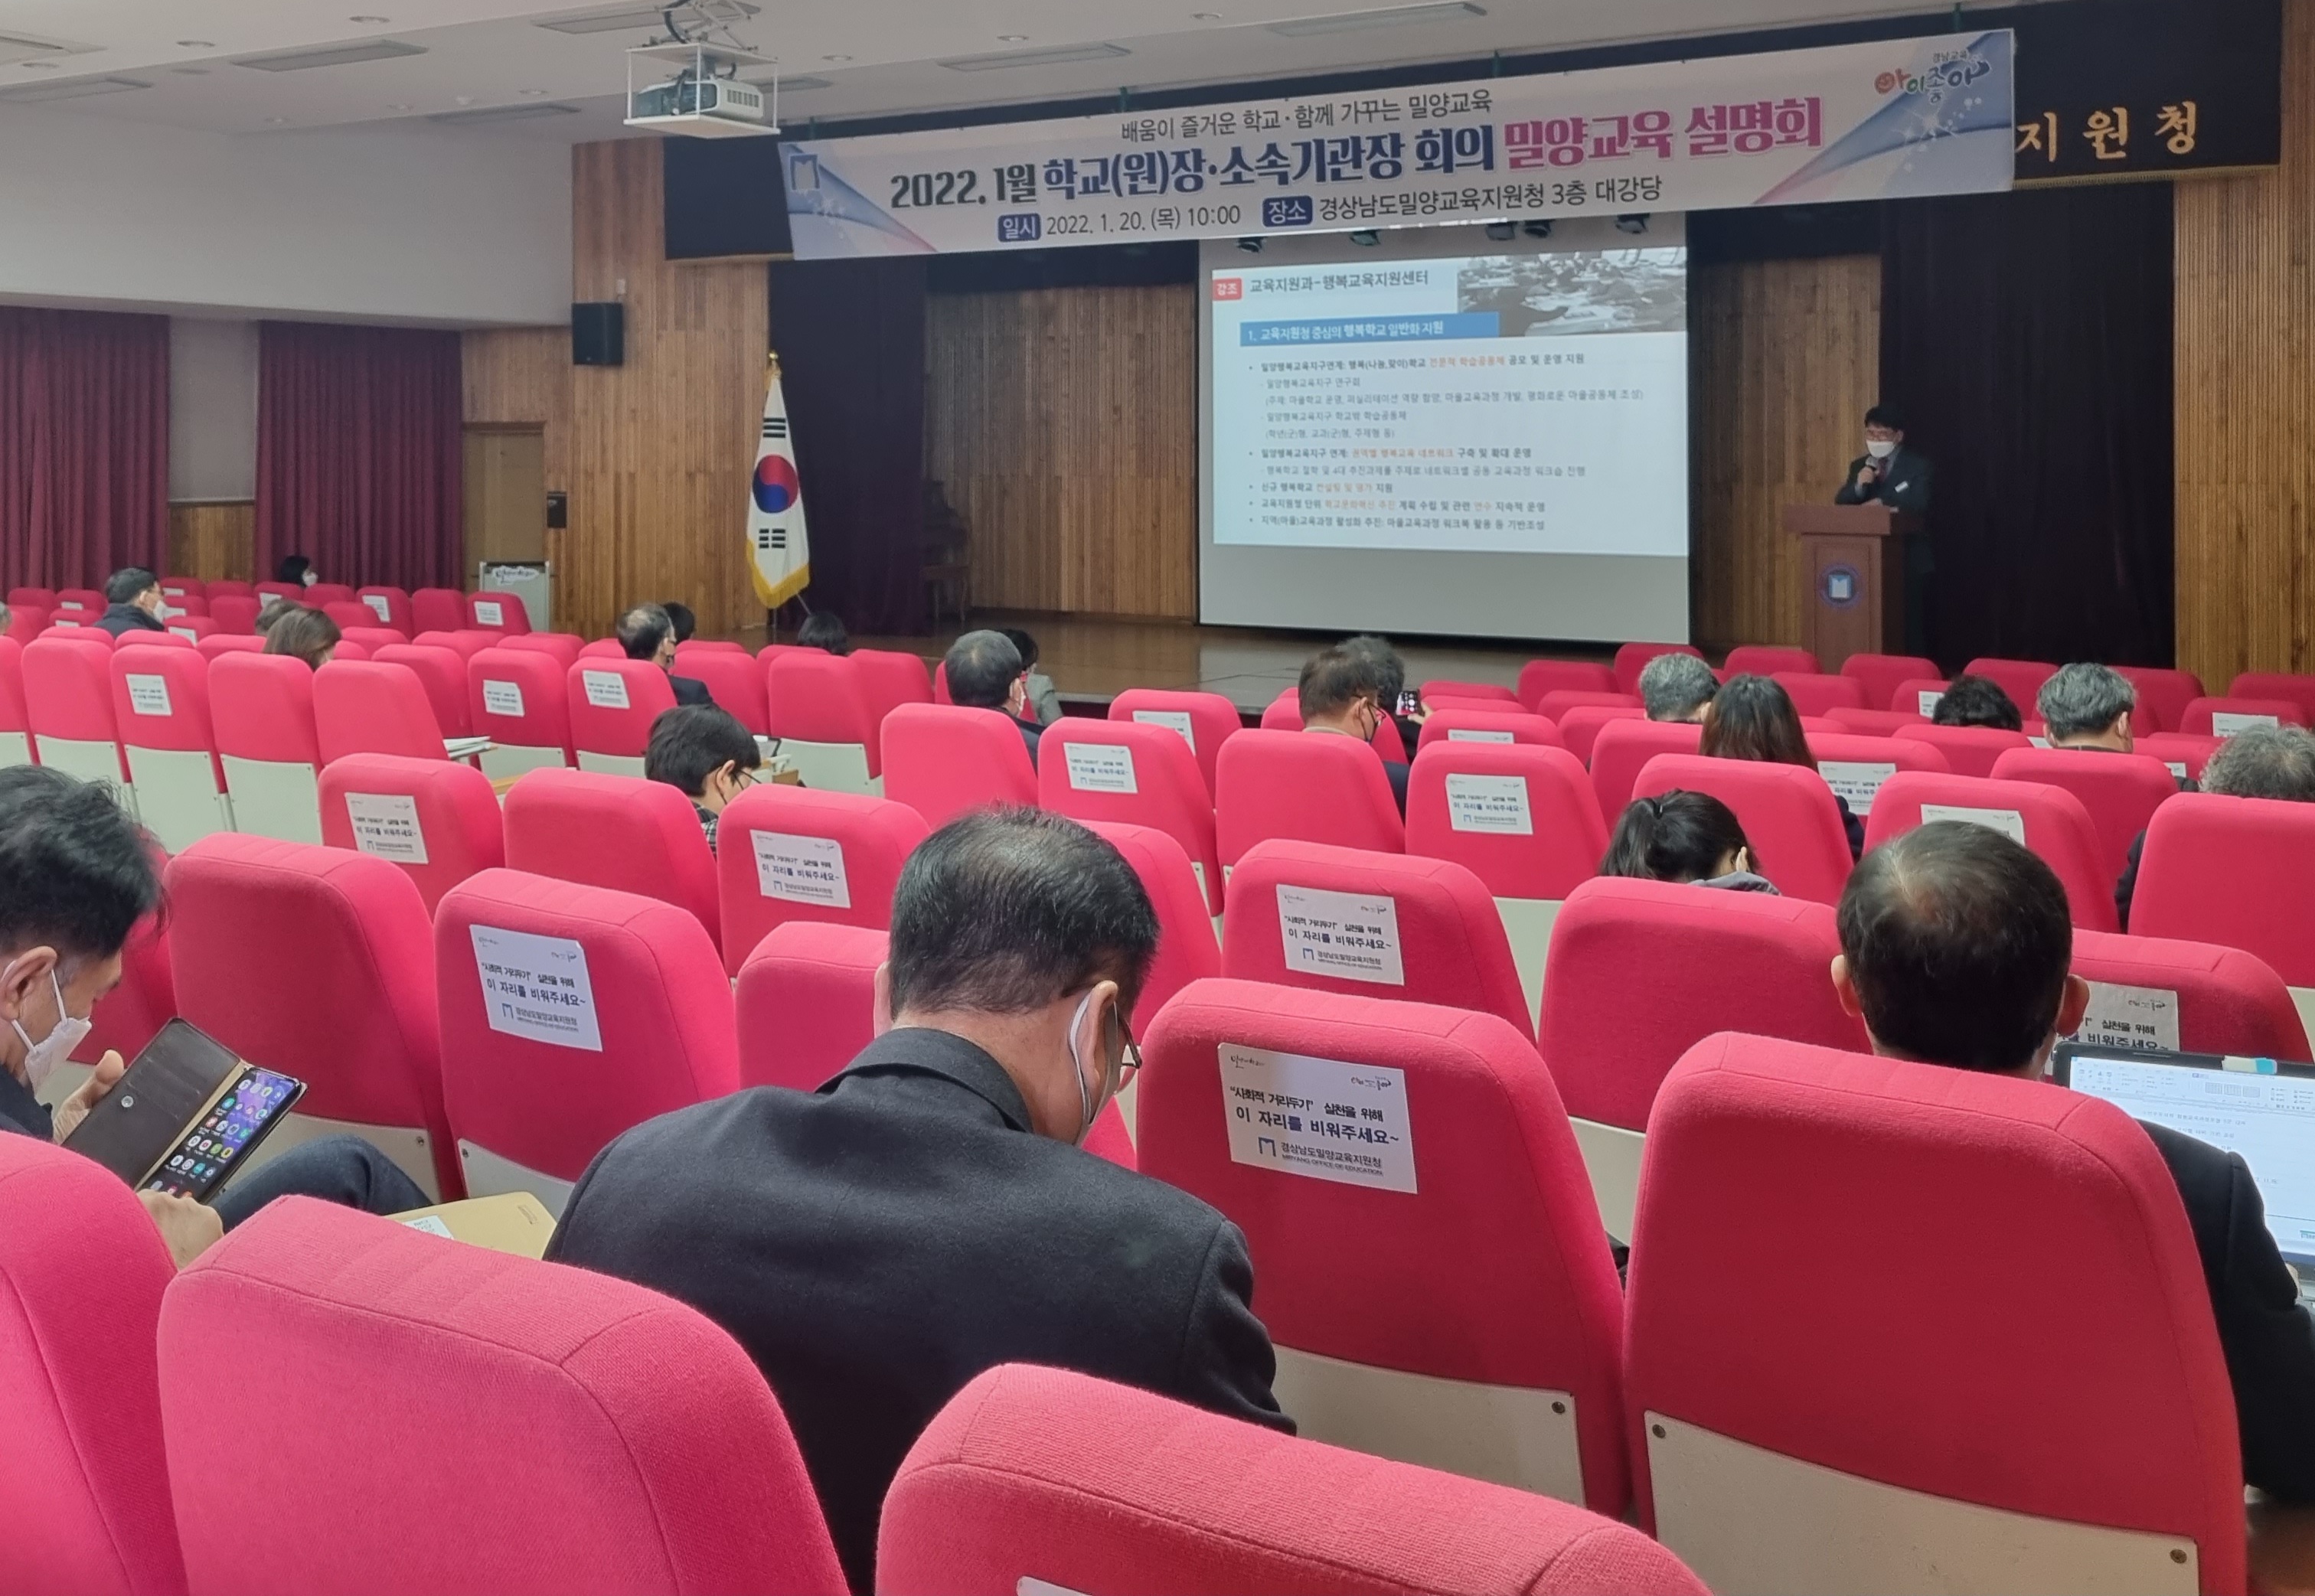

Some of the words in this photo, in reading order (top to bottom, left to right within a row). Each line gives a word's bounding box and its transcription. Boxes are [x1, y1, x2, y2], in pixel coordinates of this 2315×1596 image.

[1122, 118, 1176, 143] 배움이
[1181, 112, 1237, 139] 즐거운
[1342, 96, 1402, 125] 가꾸는
[1408, 89, 1492, 118] 밀양교육
[890, 170, 987, 209] 2022.
[994, 162, 1036, 204] 1월
[1415, 125, 1494, 174] 회의
[1504, 110, 1673, 169] 밀양교육
[1686, 96, 1823, 156] 설명회
[1002, 218, 1037, 240] 일시
[1151, 207, 1180, 231] (목)
[1188, 205, 1241, 227] 10:00
[1268, 201, 1307, 223] 장소
[1319, 184, 1545, 220] 경상남도밀양교육지원청
[1551, 181, 1586, 207] 3층
[1595, 175, 1662, 204] 대강당
[1216, 282, 1238, 296] 강조
[1260, 327, 1310, 341] 교육지원청
[1311, 325, 1340, 340] 중심의
[1344, 323, 1386, 338] 행복학교
[1388, 322, 1420, 337] 일반화
[1422, 320, 1444, 335] 지원
[1288, 928, 1298, 938] 이
[1303, 931, 1331, 944] 자리를
[487, 978, 495, 991] 이
[500, 981, 526, 998] 자리를
[2135, 1023, 2156, 1035] 위해
[1324, 1102, 1357, 1118] 실천을
[1361, 1107, 1383, 1122] 위해
[1236, 1106, 1250, 1123] 이
[1259, 1110, 1302, 1132] 자리를
[1311, 1120, 1399, 1145] 비워주세요~
[1281, 1141, 1382, 1169] 경상남도밀양교육지원청
